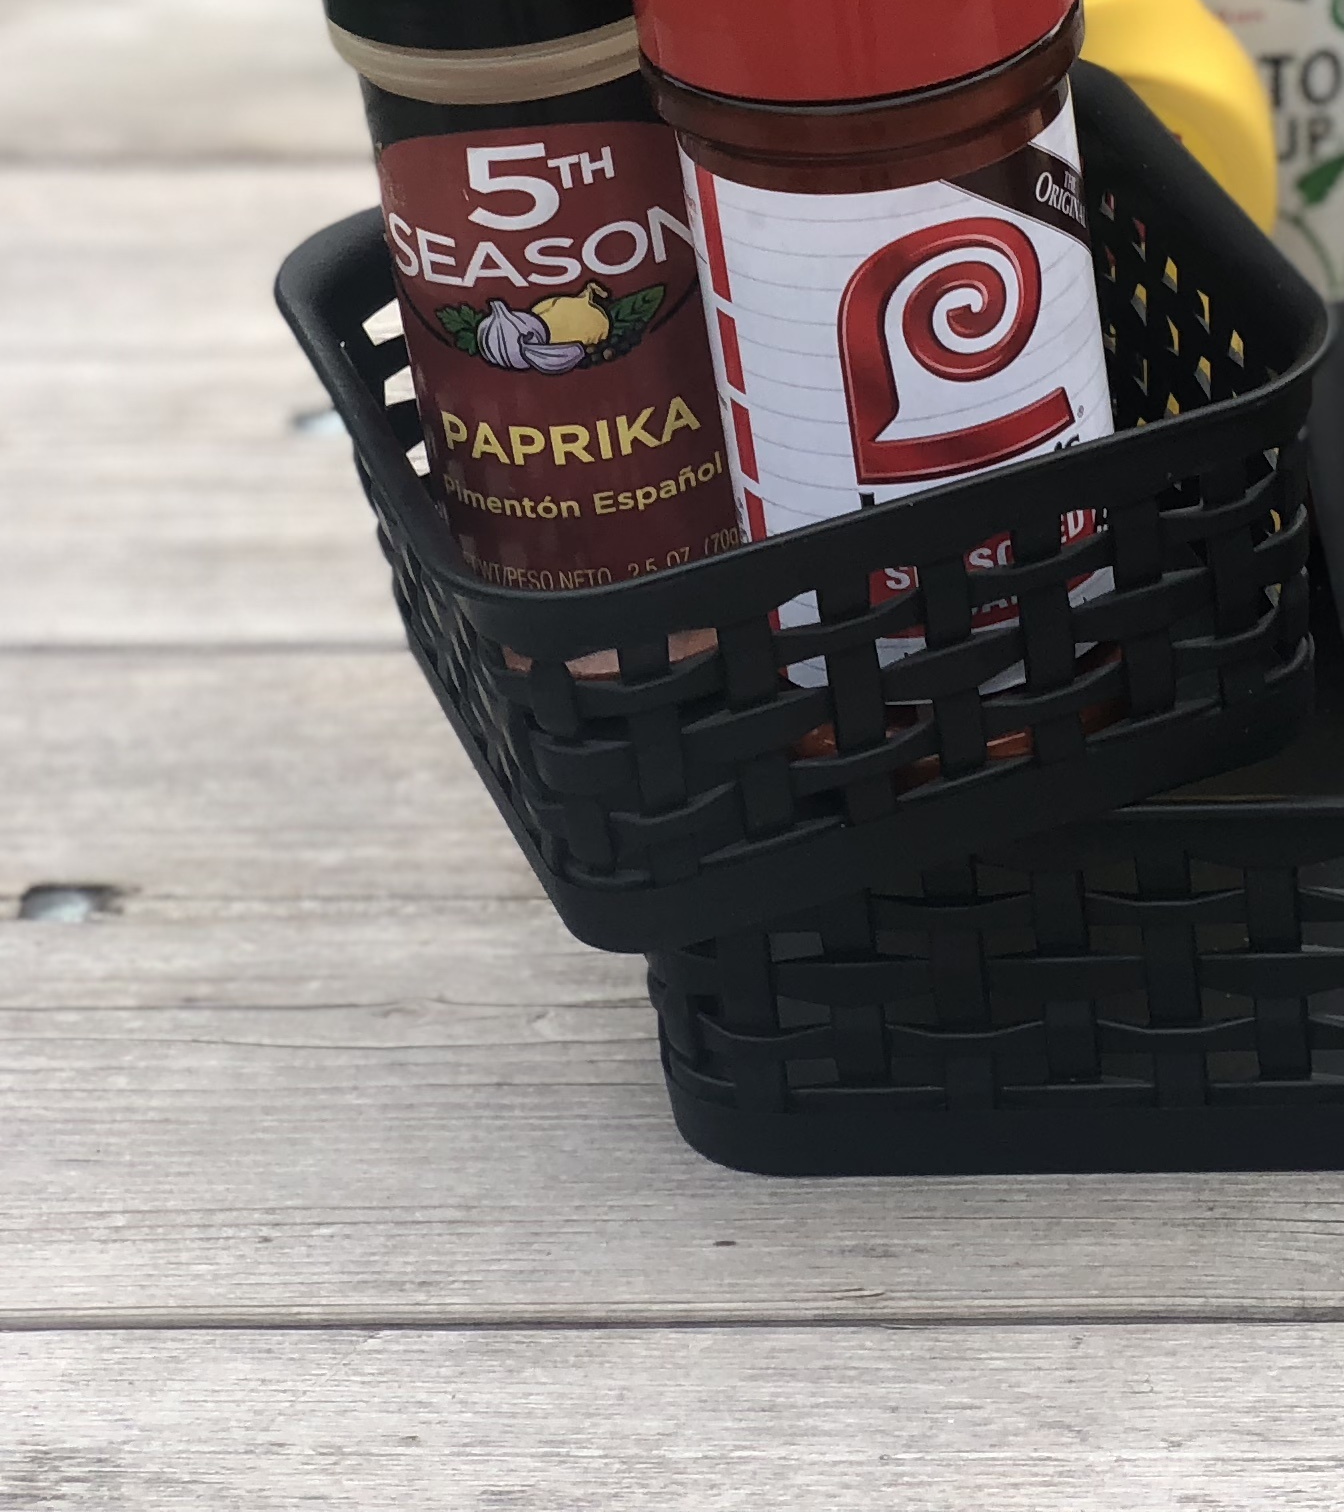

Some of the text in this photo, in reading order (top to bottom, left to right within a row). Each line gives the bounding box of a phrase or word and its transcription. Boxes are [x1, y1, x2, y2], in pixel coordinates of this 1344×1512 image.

[440, 395, 702, 467] PAPRIKA
[442, 450, 723, 520] Pimentón Español
